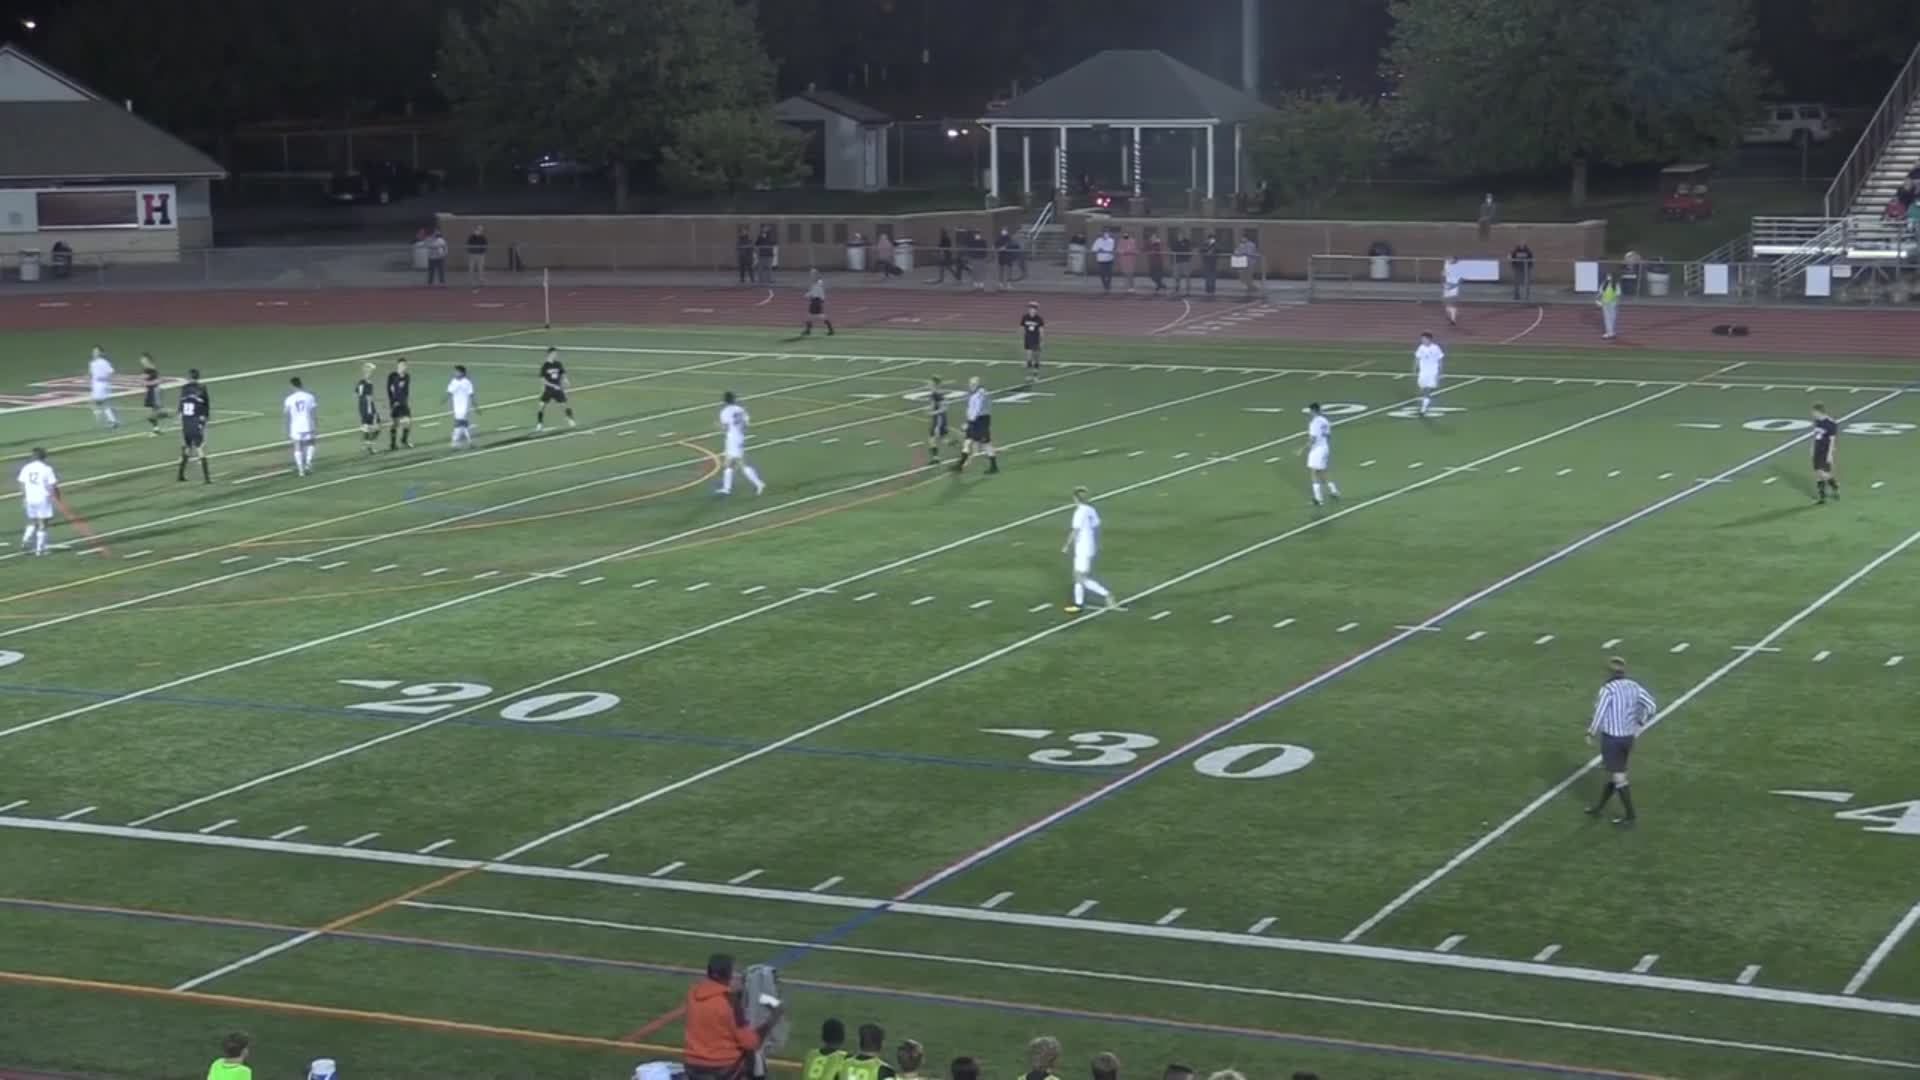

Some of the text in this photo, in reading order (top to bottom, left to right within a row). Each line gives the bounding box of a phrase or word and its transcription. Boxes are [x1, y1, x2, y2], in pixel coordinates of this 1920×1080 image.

[143, 193, 171, 226] H
[344, 681, 621, 723] 20
[1027, 730, 1315, 779] 30
